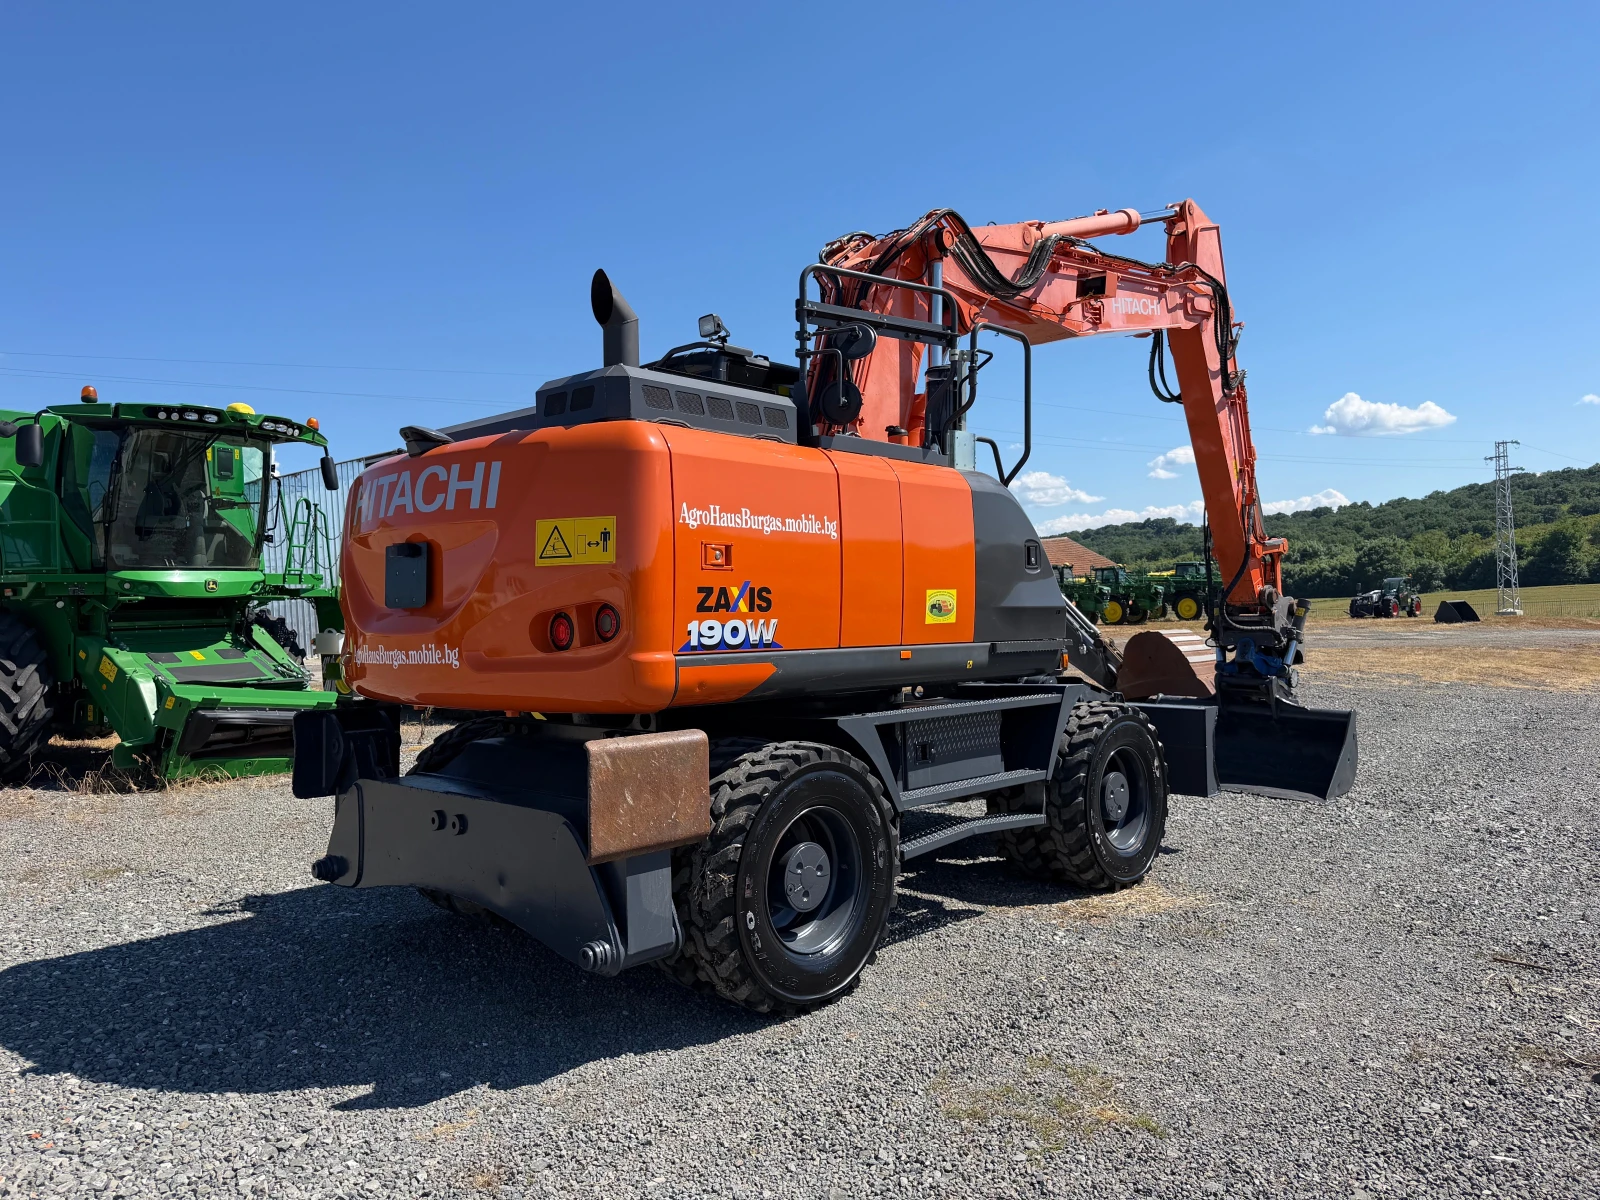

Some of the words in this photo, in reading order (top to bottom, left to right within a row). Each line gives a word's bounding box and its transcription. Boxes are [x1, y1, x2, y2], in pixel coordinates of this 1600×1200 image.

[1111, 297, 1161, 316] HITACHI
[353, 461, 503, 526] HITACHI
[679, 502, 838, 540] AgroHausBurgas.mobile.bg
[696, 580, 772, 613] ZAXIS
[687, 619, 779, 650] 190W
